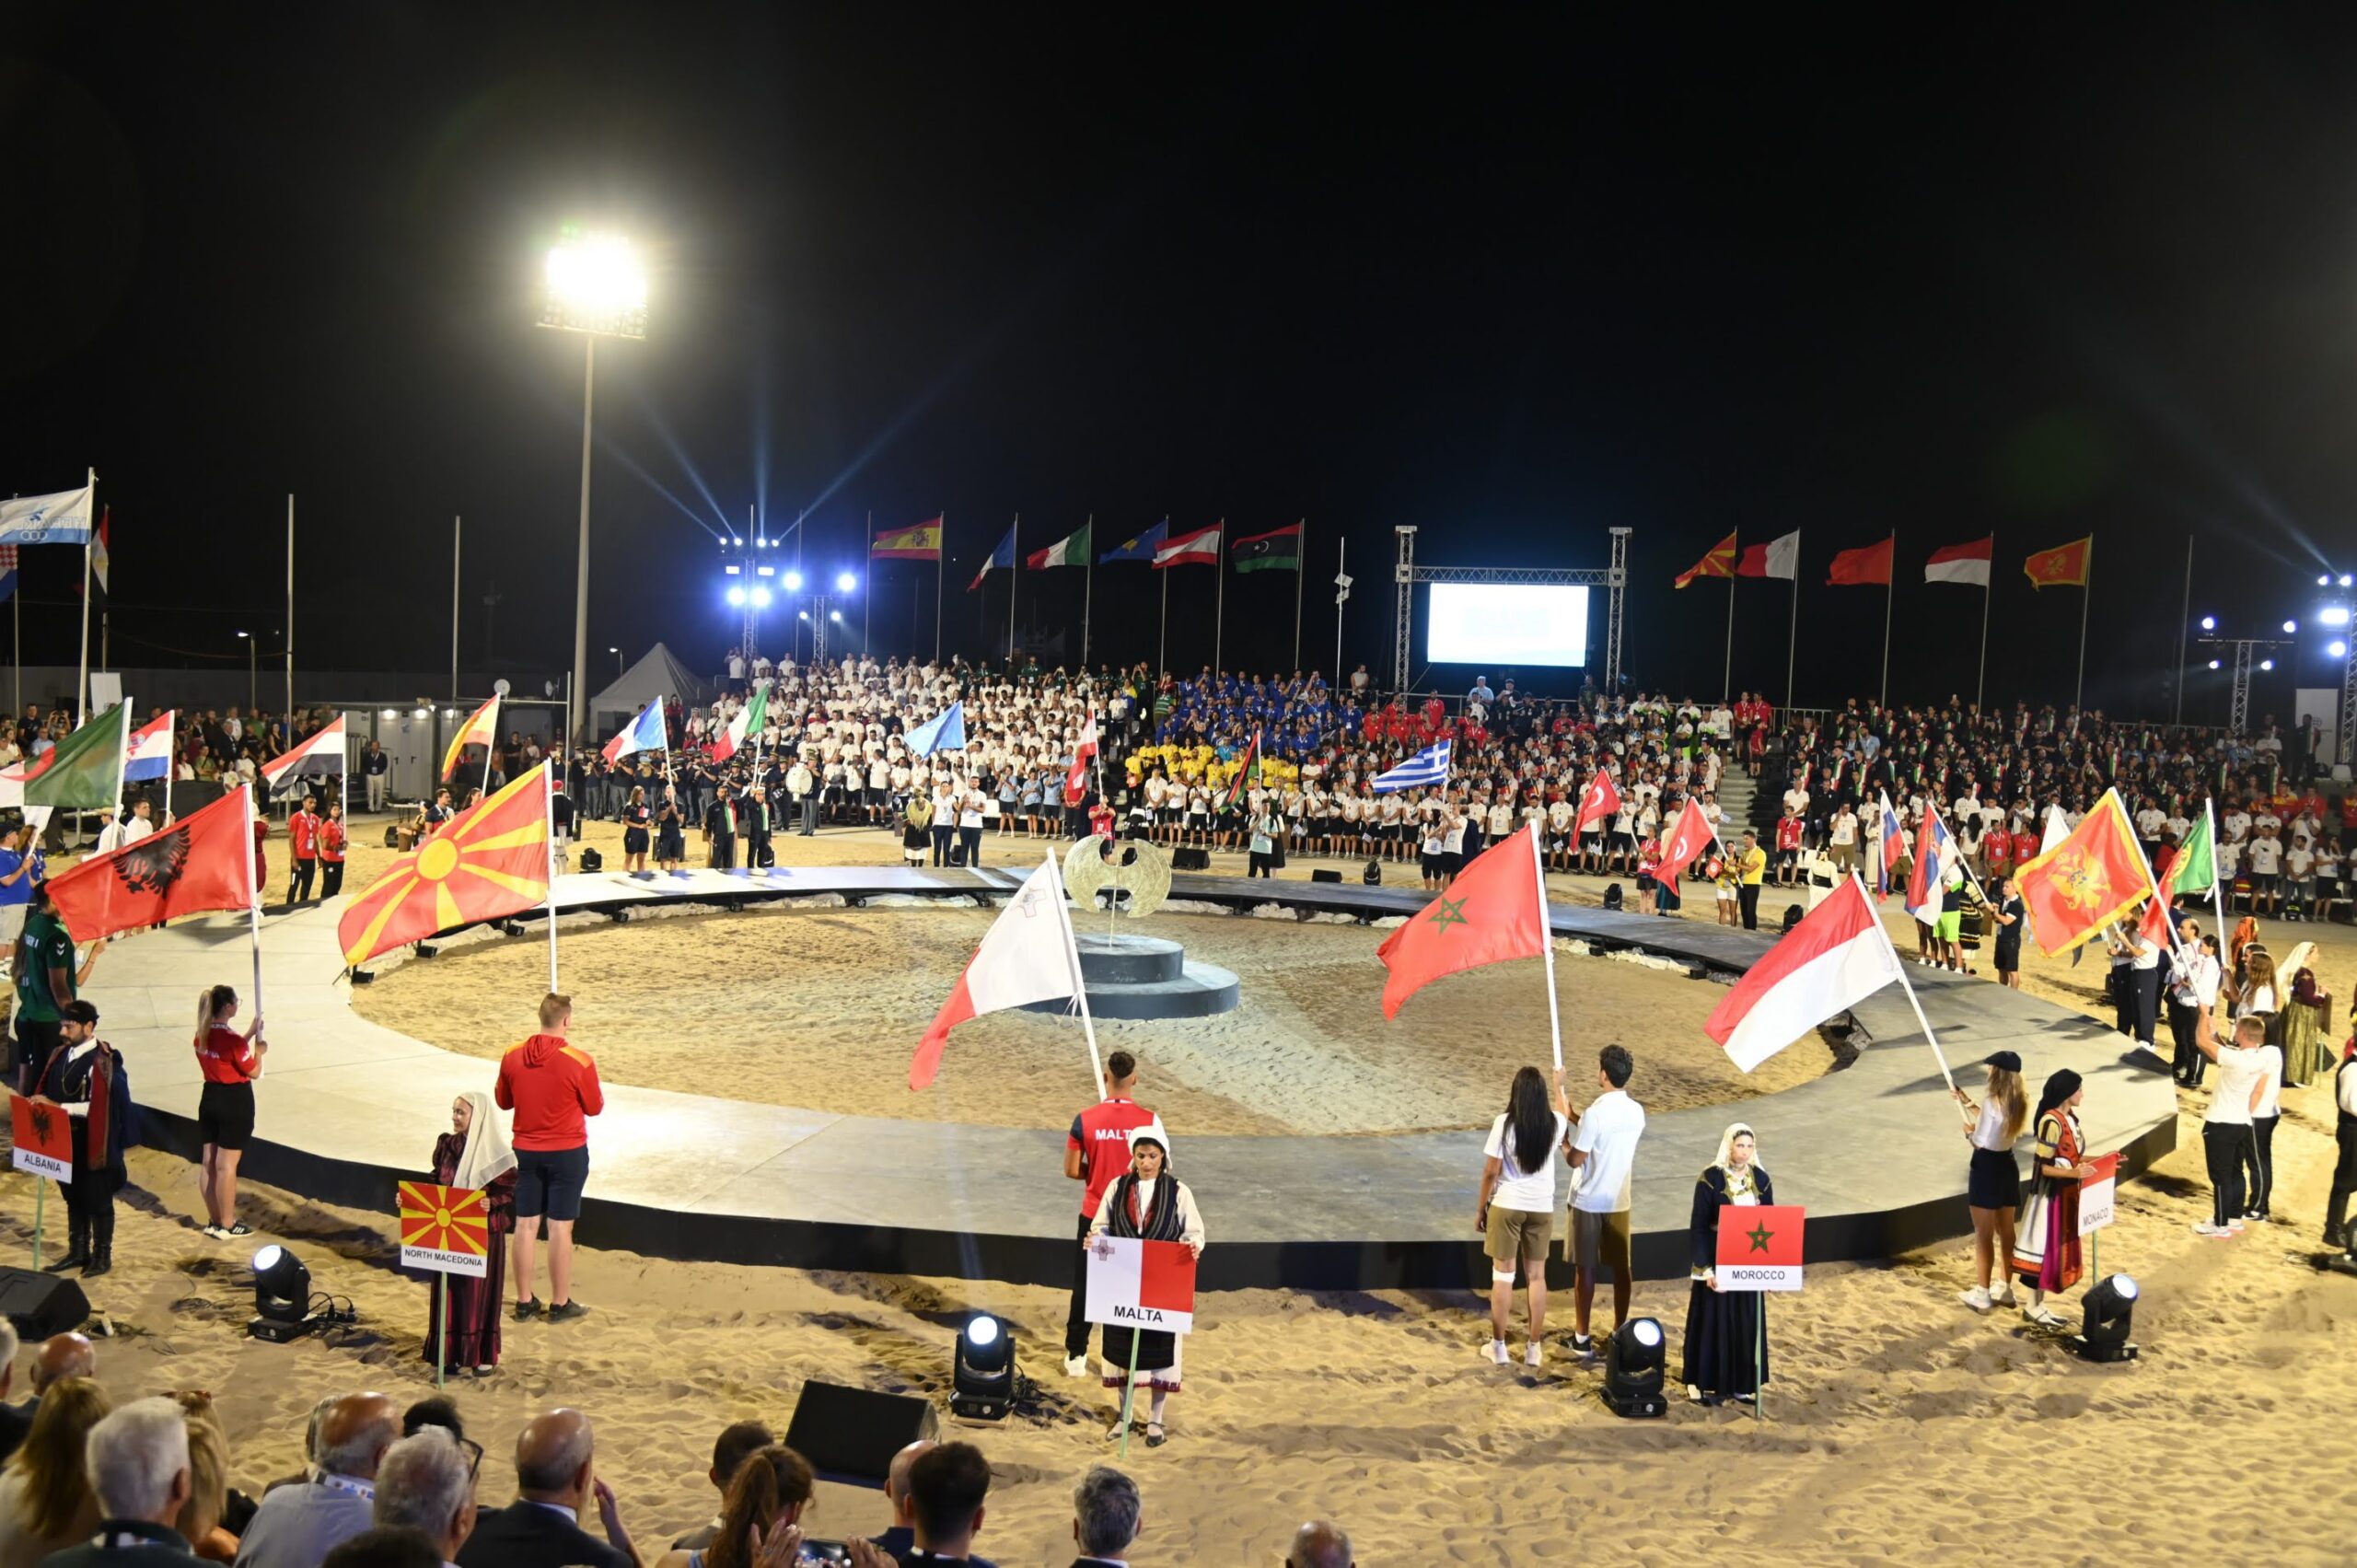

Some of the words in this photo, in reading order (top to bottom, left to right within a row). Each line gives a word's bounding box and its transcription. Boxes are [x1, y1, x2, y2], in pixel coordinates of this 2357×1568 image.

[1096, 1129, 1132, 1140] MALT
[24, 1154, 62, 1173] ALBANIA
[2083, 1207, 2108, 1226] MONACO
[404, 1249, 433, 1260] NORTH
[434, 1252, 482, 1267] MACEDONIA
[1732, 1270, 1785, 1280] MOROCCO
[1114, 1305, 1163, 1323] MALTA
